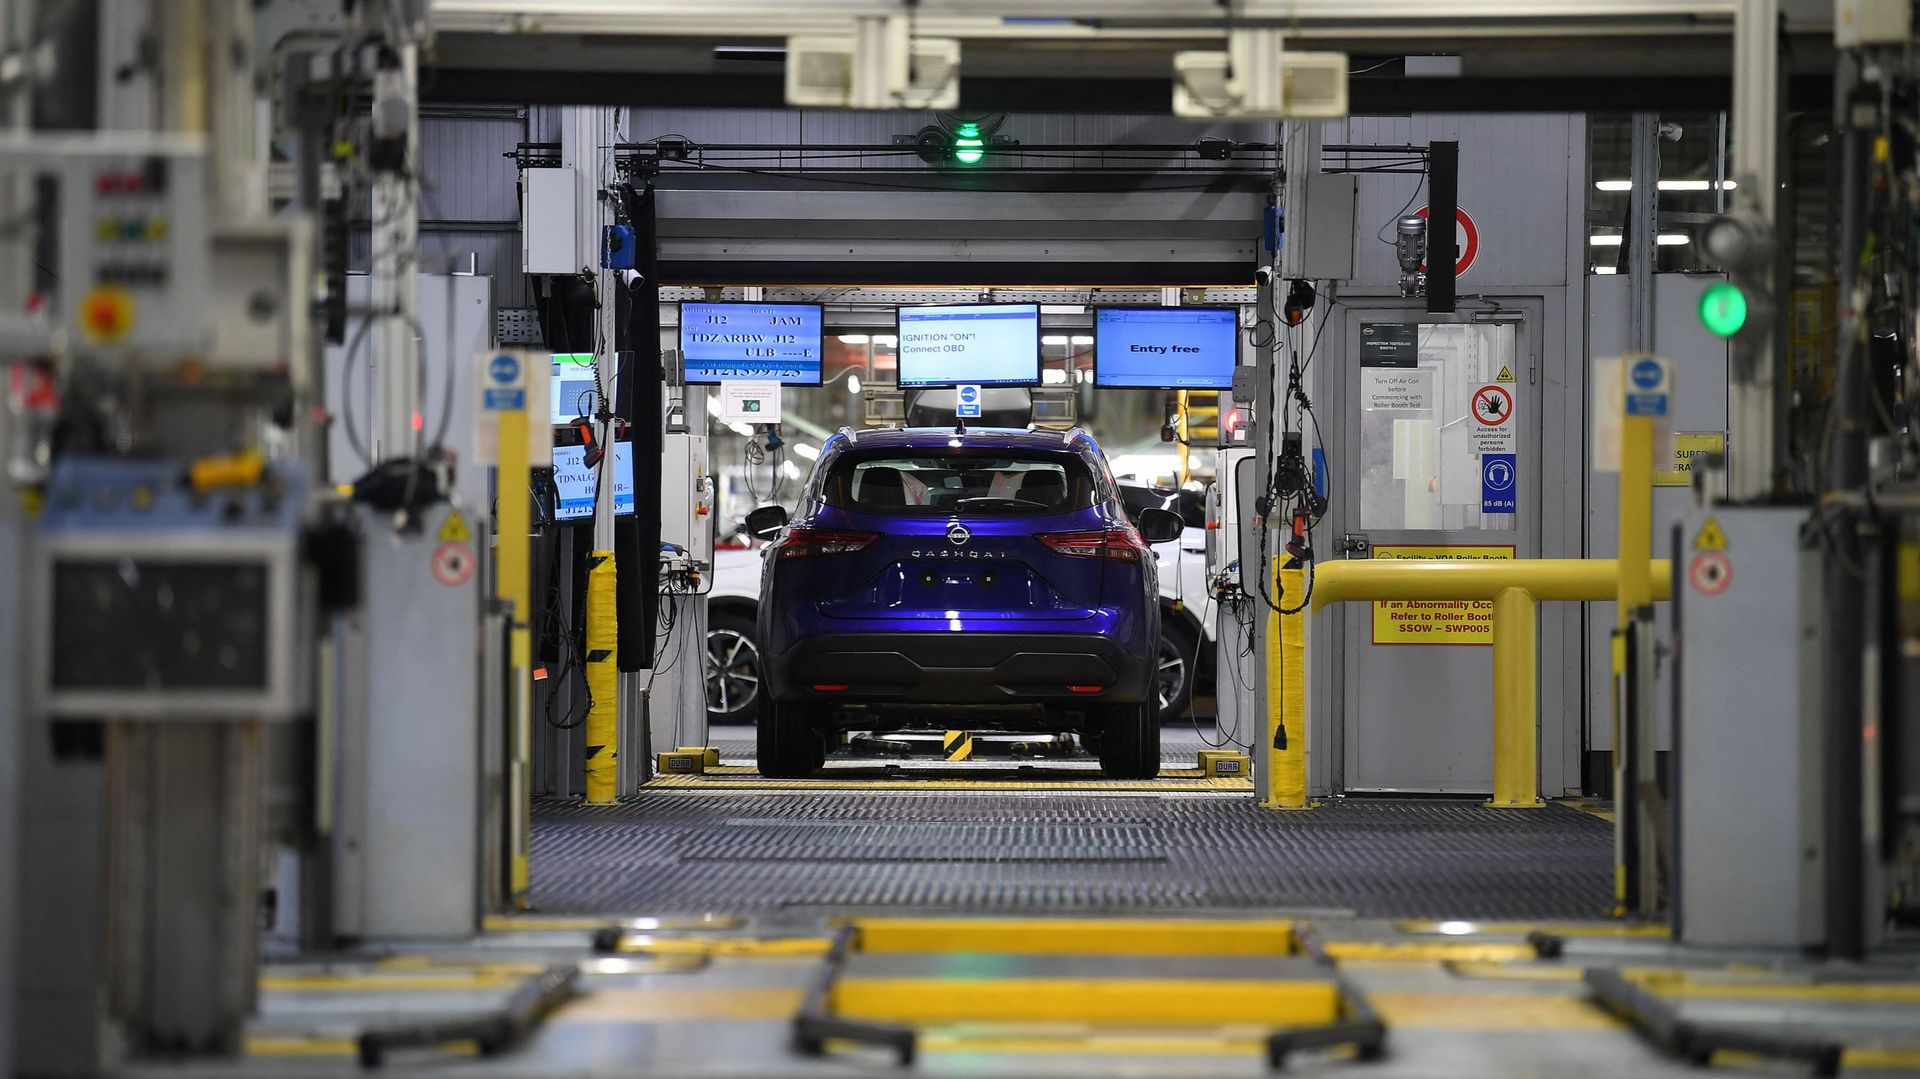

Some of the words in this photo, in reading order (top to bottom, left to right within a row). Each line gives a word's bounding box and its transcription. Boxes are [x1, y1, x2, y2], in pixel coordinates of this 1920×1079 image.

[705, 316, 728, 325] J12
[770, 317, 801, 326] JAM
[689, 334, 765, 343] TDZARBW
[773, 336, 796, 344] J12
[903, 334, 948, 342] IGNITION
[950, 333, 976, 341] "ON"!
[745, 348, 775, 357] ULB
[1131, 345, 1167, 354] Entry
[1172, 345, 1200, 353] free
[567, 457, 580, 466] J12
[1381, 600, 1387, 608] If
[1406, 600, 1469, 610] Abnormality
